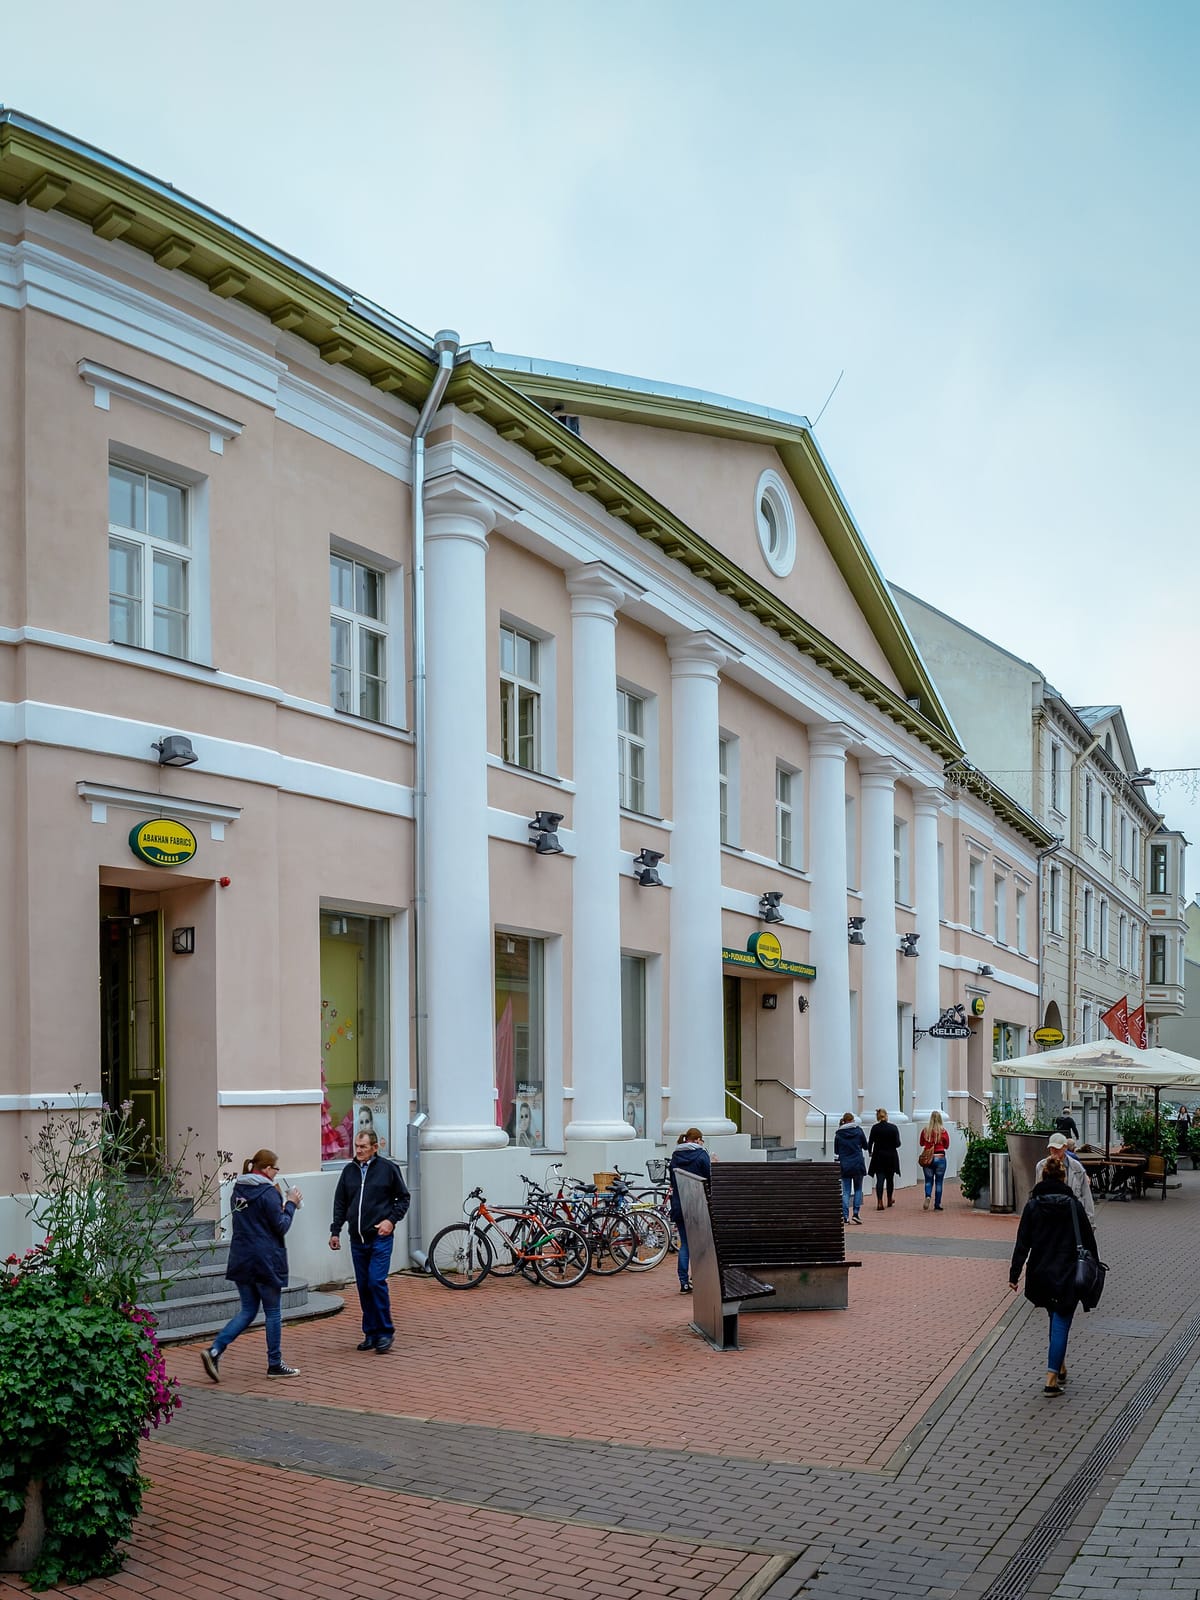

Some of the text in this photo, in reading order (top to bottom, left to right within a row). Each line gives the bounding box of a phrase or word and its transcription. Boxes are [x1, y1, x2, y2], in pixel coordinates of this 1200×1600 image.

[143, 833, 192, 847] ABAKHAN FABRICS
[932, 1028, 967, 1036] KELLER
